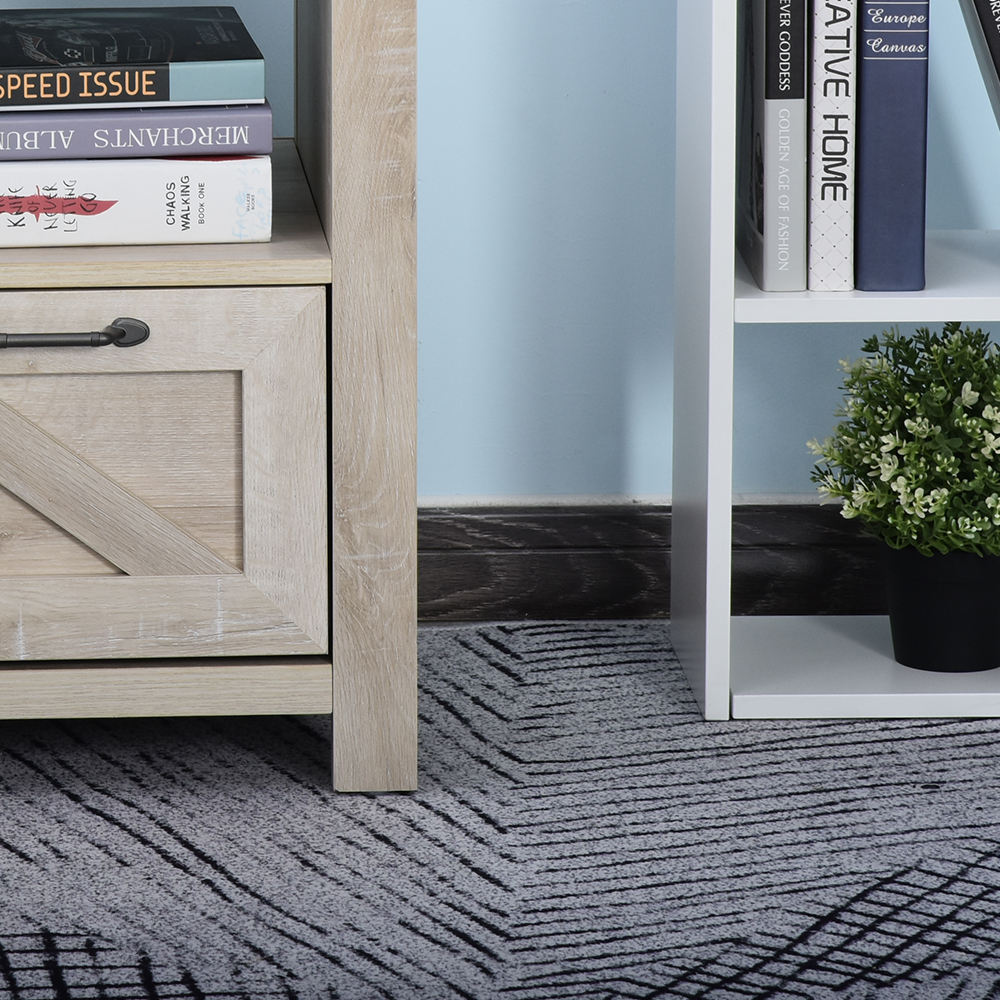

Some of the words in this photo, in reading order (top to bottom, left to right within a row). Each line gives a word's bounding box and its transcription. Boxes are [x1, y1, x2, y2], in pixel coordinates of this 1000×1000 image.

[867, 8, 927, 28] Europe
[866, 37, 927, 53] Canvas
[778, 31, 791, 91] GODDESS
[79, 70, 156, 97] ISSUE
[93, 125, 250, 149] MERCHANTS
[778, 108, 791, 162] GOLDEN
[820, 114, 849, 202] HOME
[778, 166, 790, 191] AGE
[79, 192, 97, 213] GO
[165, 182, 176, 226] CHAOS
[180, 175, 191, 232] WALKING
[778, 195, 790, 212] OF
[777, 218, 790, 271] FASHION
